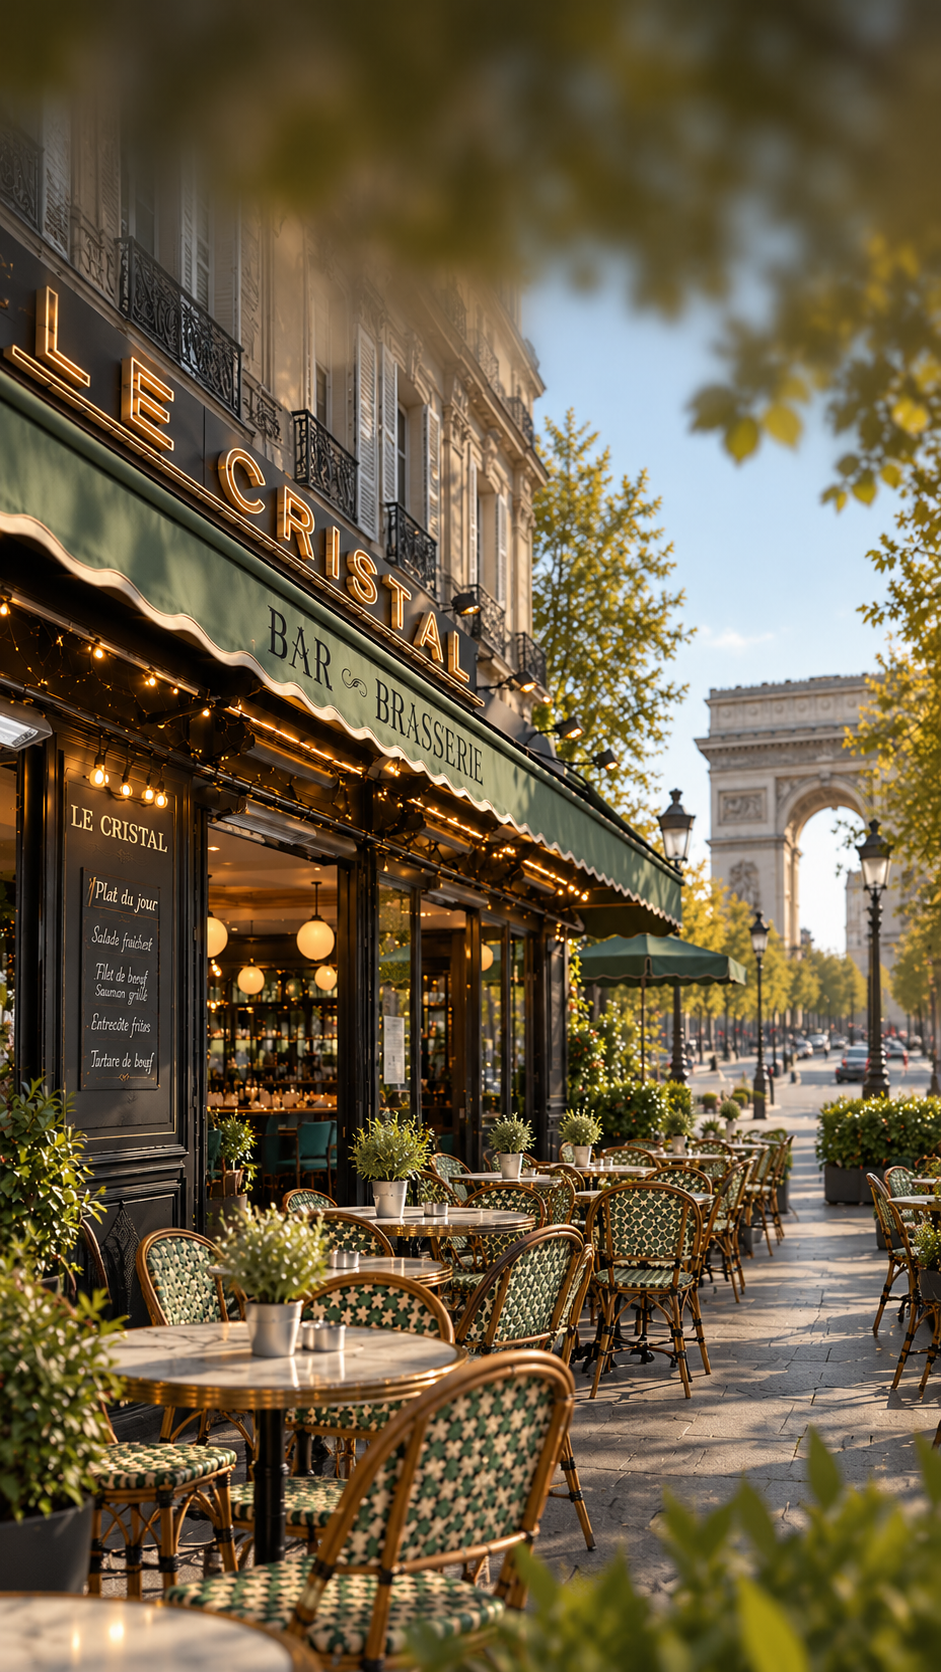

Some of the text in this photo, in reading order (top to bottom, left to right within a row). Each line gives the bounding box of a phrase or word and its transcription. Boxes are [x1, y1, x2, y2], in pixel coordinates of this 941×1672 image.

[35, 285, 471, 684] LE CRISTAL
[267, 604, 484, 787] BAR BRASSERIE
[70, 804, 168, 853] LE CRISTAL
[94, 880, 159, 914] Plat du jour
[115, 966, 126, 983] de
[121, 1052, 132, 1068] de
